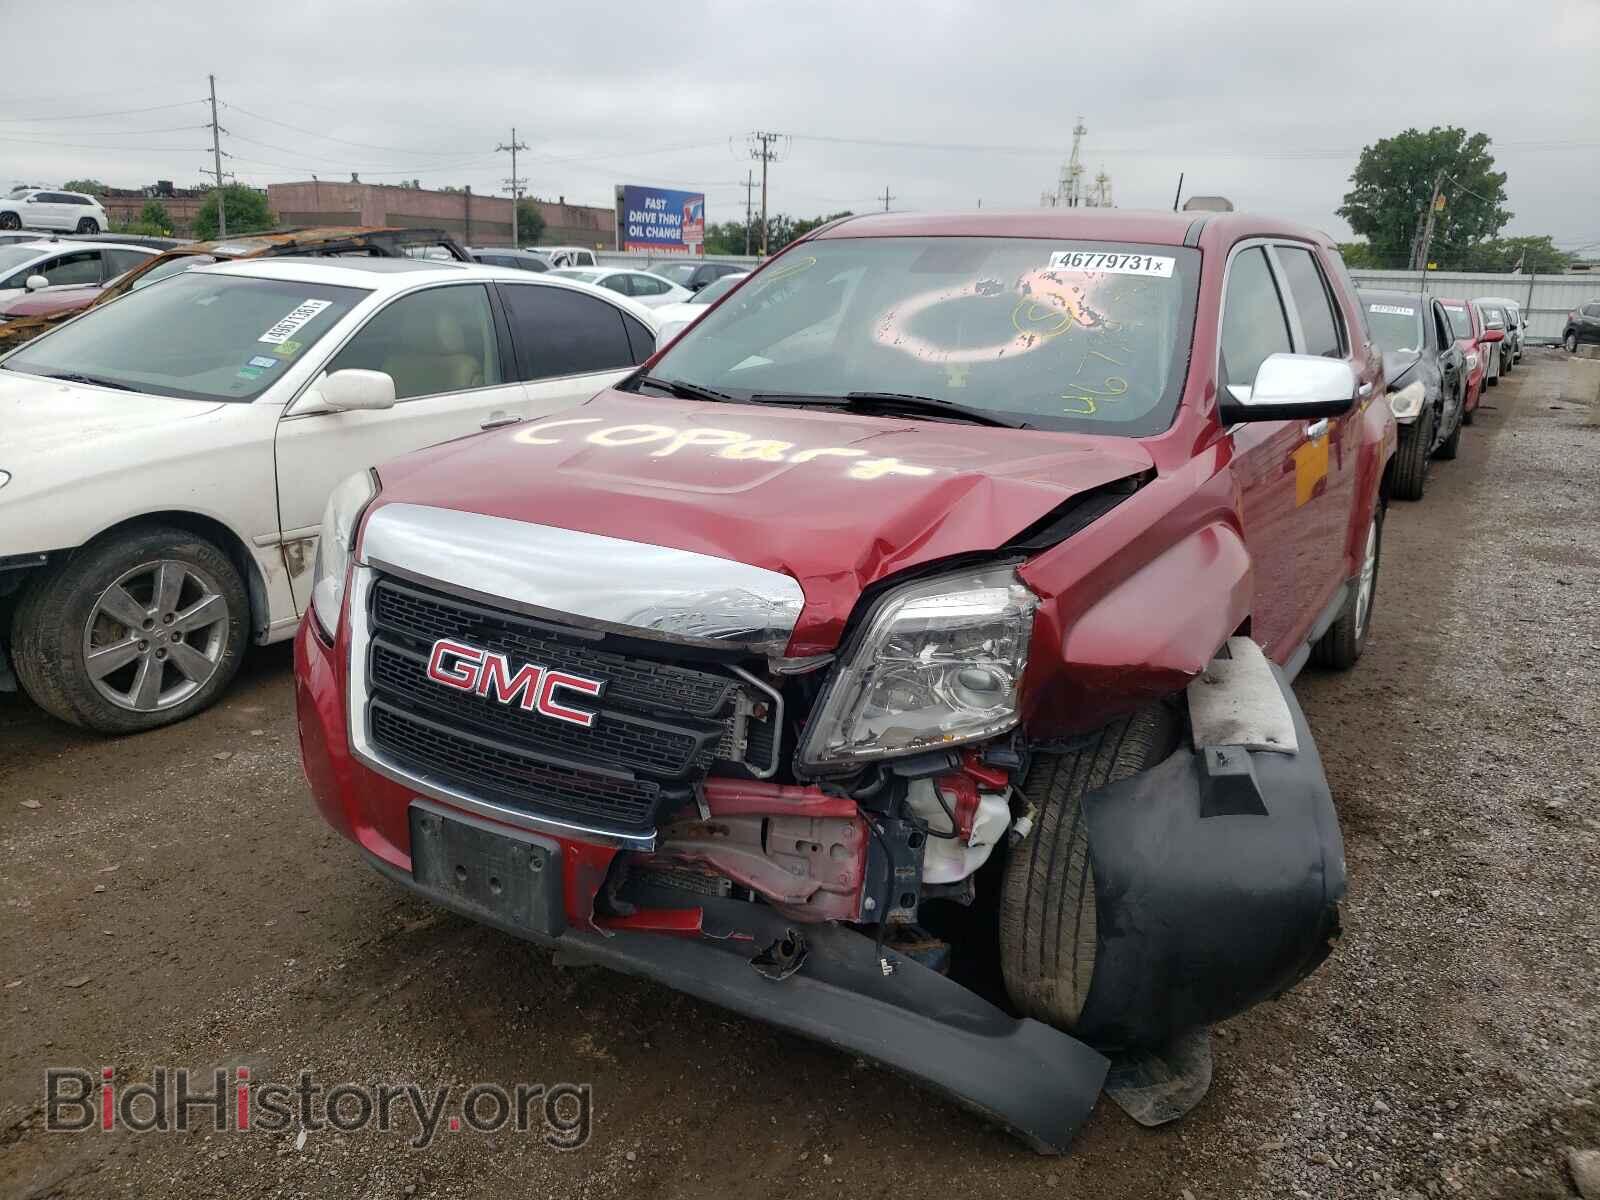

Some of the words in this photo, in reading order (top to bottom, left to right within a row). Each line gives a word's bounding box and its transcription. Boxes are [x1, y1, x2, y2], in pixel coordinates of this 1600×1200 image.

[644, 197, 667, 210] FAST
[629, 210, 657, 224] DRIVE
[659, 212, 681, 226] THRU
[629, 225, 644, 238] OIL
[646, 226, 681, 240] CHANGE
[427, 638, 603, 727] GMC
